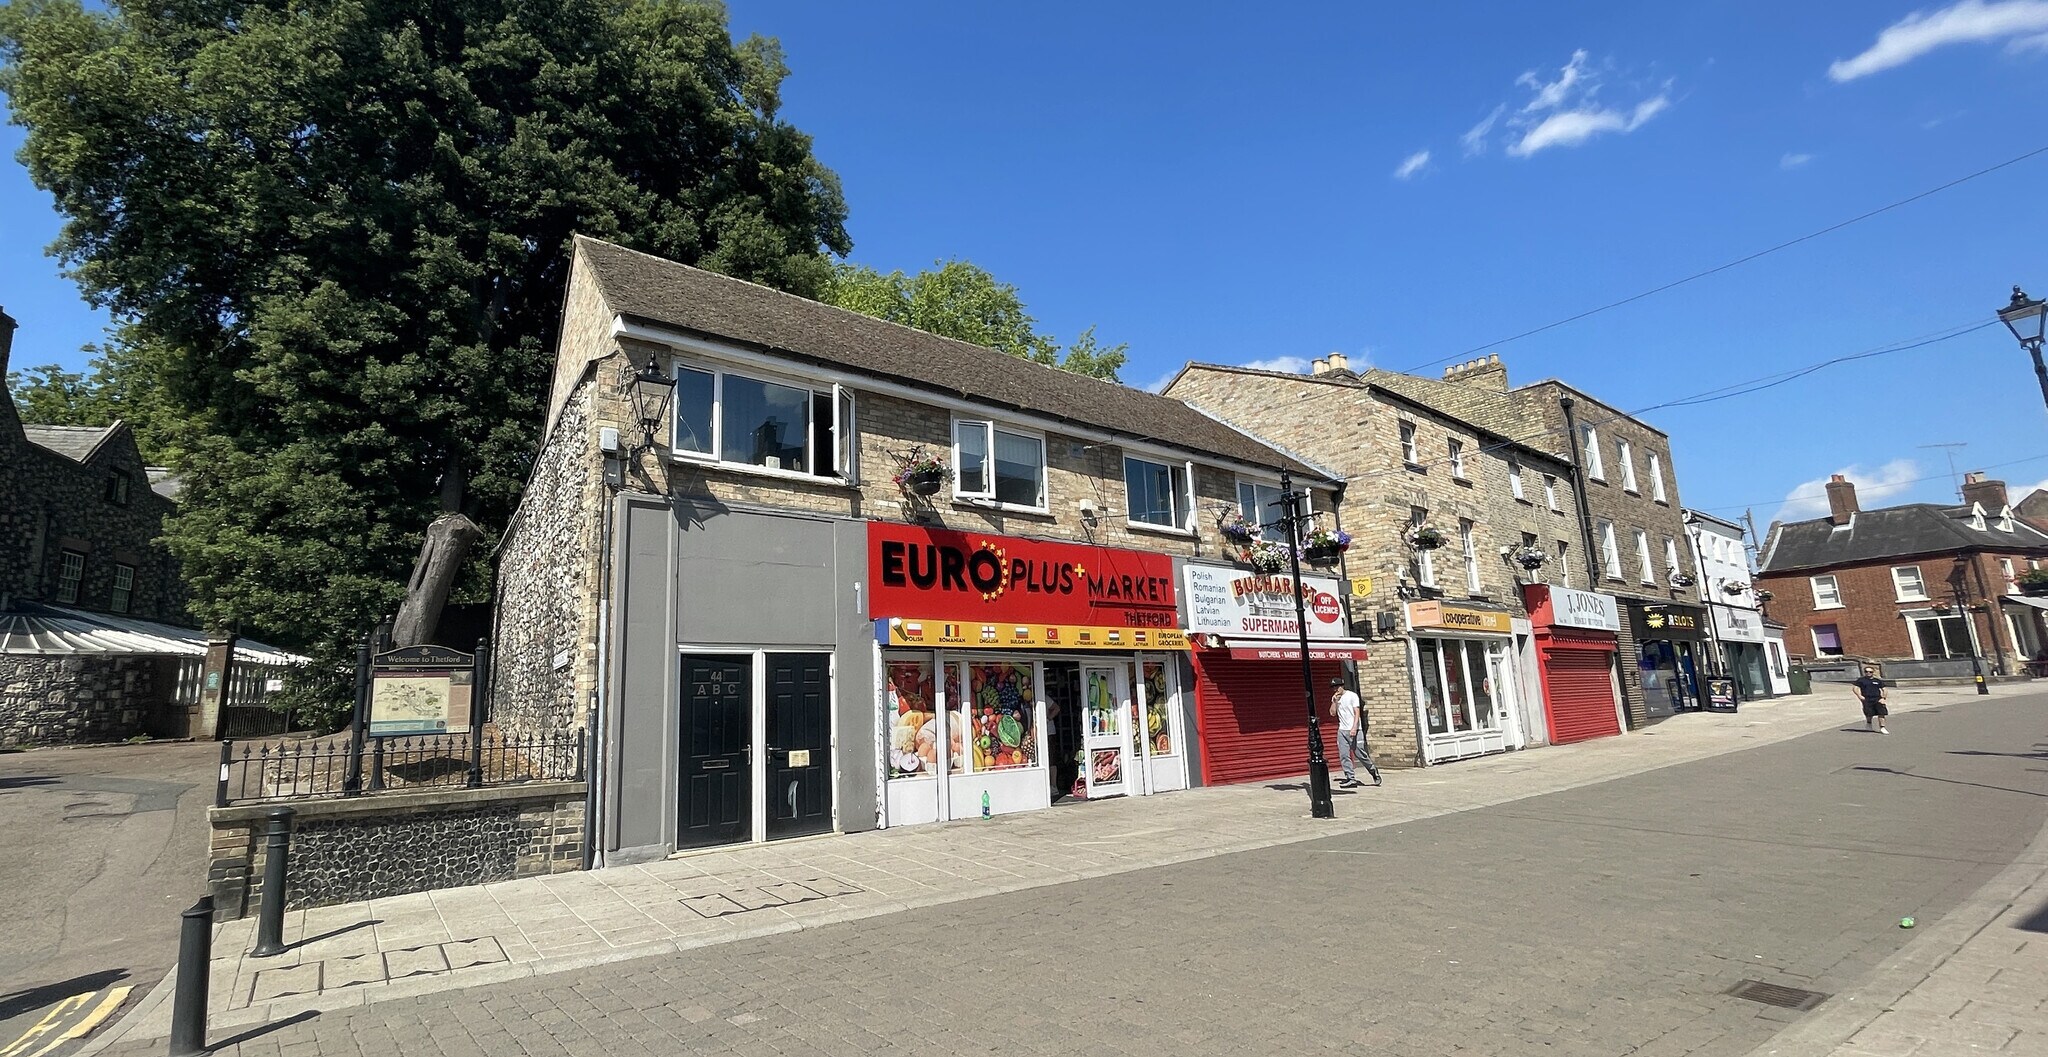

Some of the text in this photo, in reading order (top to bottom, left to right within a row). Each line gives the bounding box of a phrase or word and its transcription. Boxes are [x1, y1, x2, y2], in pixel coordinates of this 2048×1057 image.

[881, 540, 1002, 593] EURO
[1087, 573, 1169, 601] MARKET
[1192, 571, 1213, 580] Polish
[1193, 582, 1226, 593] Romanian
[1234, 576, 1318, 603] BUCHARST
[1195, 594, 1226, 606] Bulgarian
[1320, 596, 1332, 605] OFF
[1196, 605, 1220, 615] Latvian
[1314, 605, 1339, 615] LICENCE
[1124, 611, 1172, 627] THETFORD
[1197, 617, 1231, 627] Lithuanian
[1446, 612, 1481, 627] co-operative
[1674, 614, 1695, 628] SLOTS
[1242, 617, 1313, 634] SUPERMARKT
[387, 655, 420, 663] Welcome
[430, 655, 461, 663] Thetford
[710, 671, 722, 682] 44
[697, 683, 736, 695] A B C
